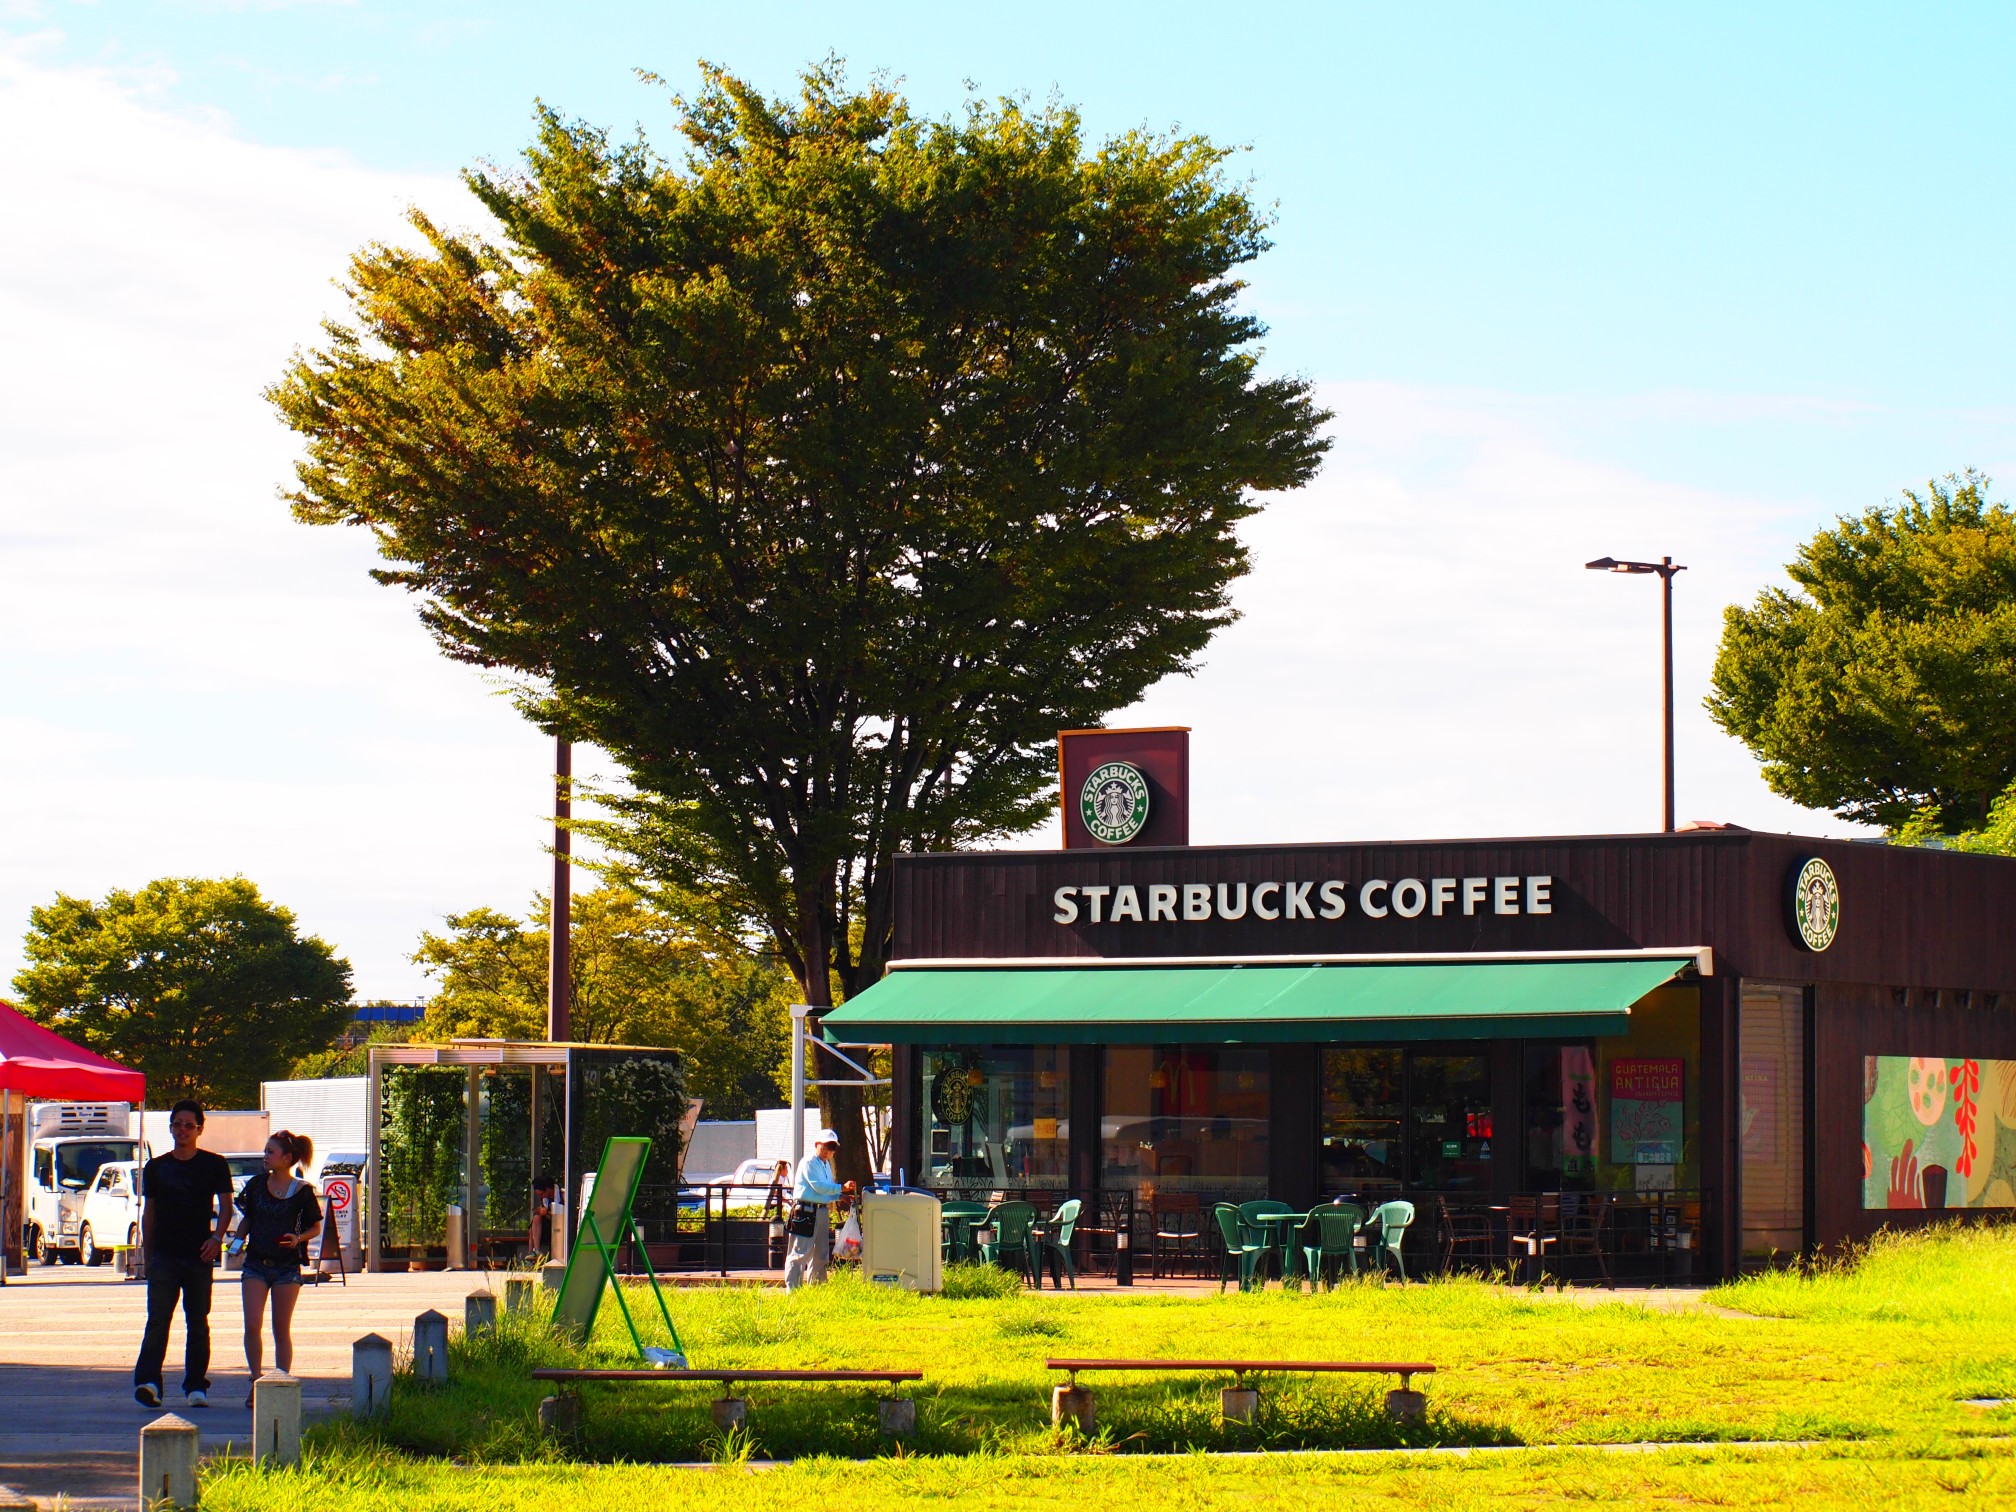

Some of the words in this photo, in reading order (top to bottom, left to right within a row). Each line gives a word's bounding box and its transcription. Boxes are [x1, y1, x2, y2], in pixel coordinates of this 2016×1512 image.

[1083, 766, 1145, 803] STARBUCKS
[1090, 818, 1139, 840] COFFEE
[1798, 862, 1837, 904] STARBUCKS
[1052, 880, 1346, 925] STARBUCKS
[1359, 875, 1552, 919] COFFEE
[1802, 921, 1833, 947] COFFEE
[1615, 1064, 1678, 1074] GUATEMALA
[1615, 1076, 1679, 1090] ANTIGUA
